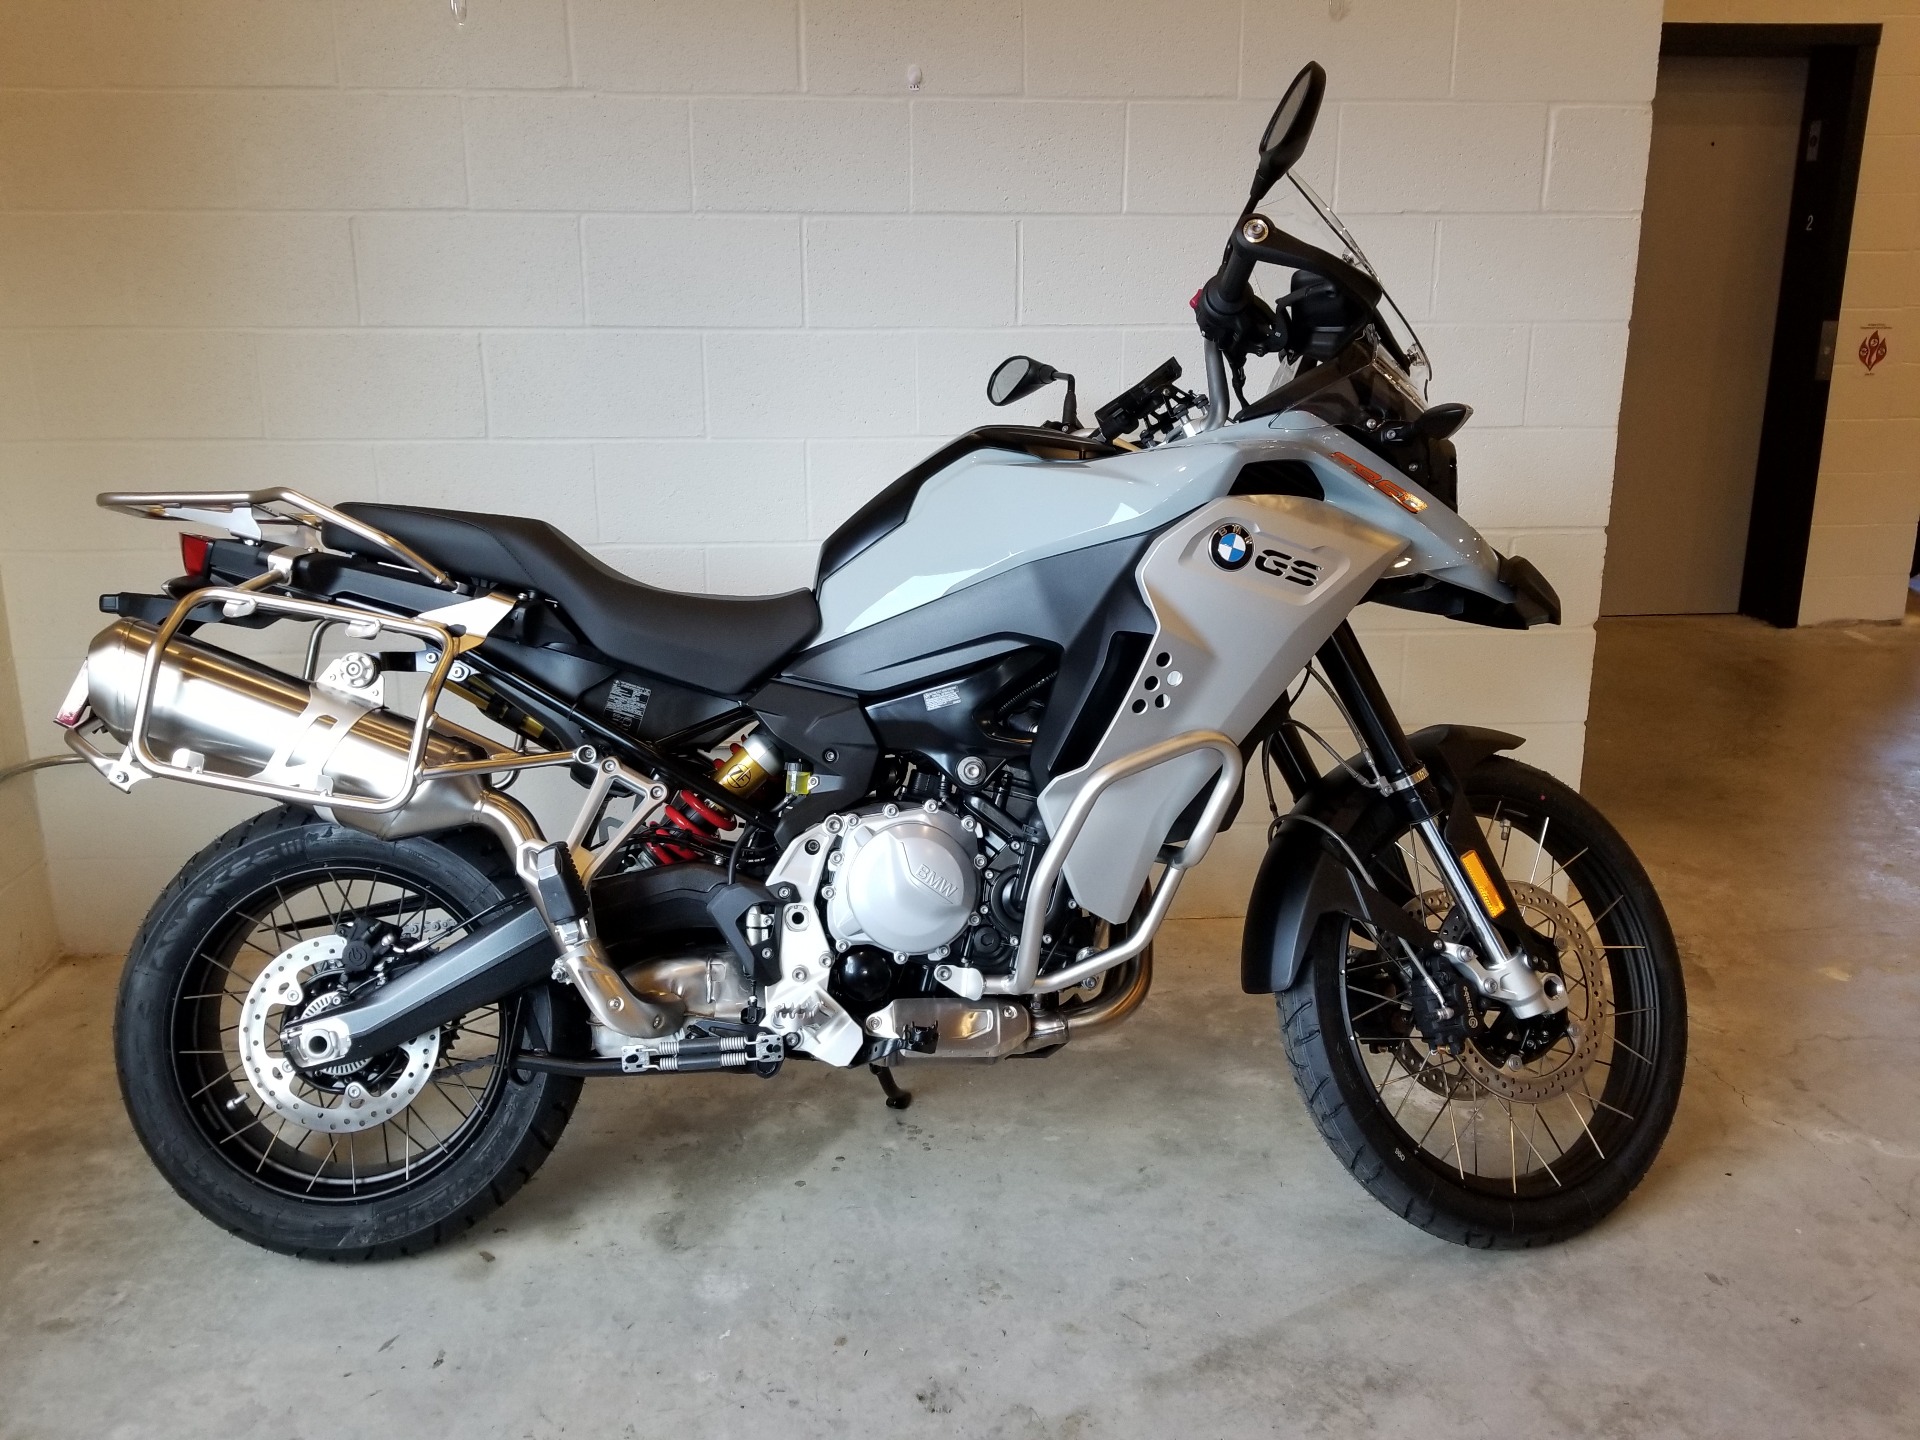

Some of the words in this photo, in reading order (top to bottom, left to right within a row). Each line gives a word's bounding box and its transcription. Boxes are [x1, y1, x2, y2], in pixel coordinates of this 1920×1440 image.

[1806, 214, 1813, 231] 2
[1218, 524, 1253, 545] BMW
[1254, 549, 1324, 587] GS
[727, 763, 752, 788] ZF
[914, 863, 959, 898] BMW
[1463, 985, 1475, 1017] brembo
